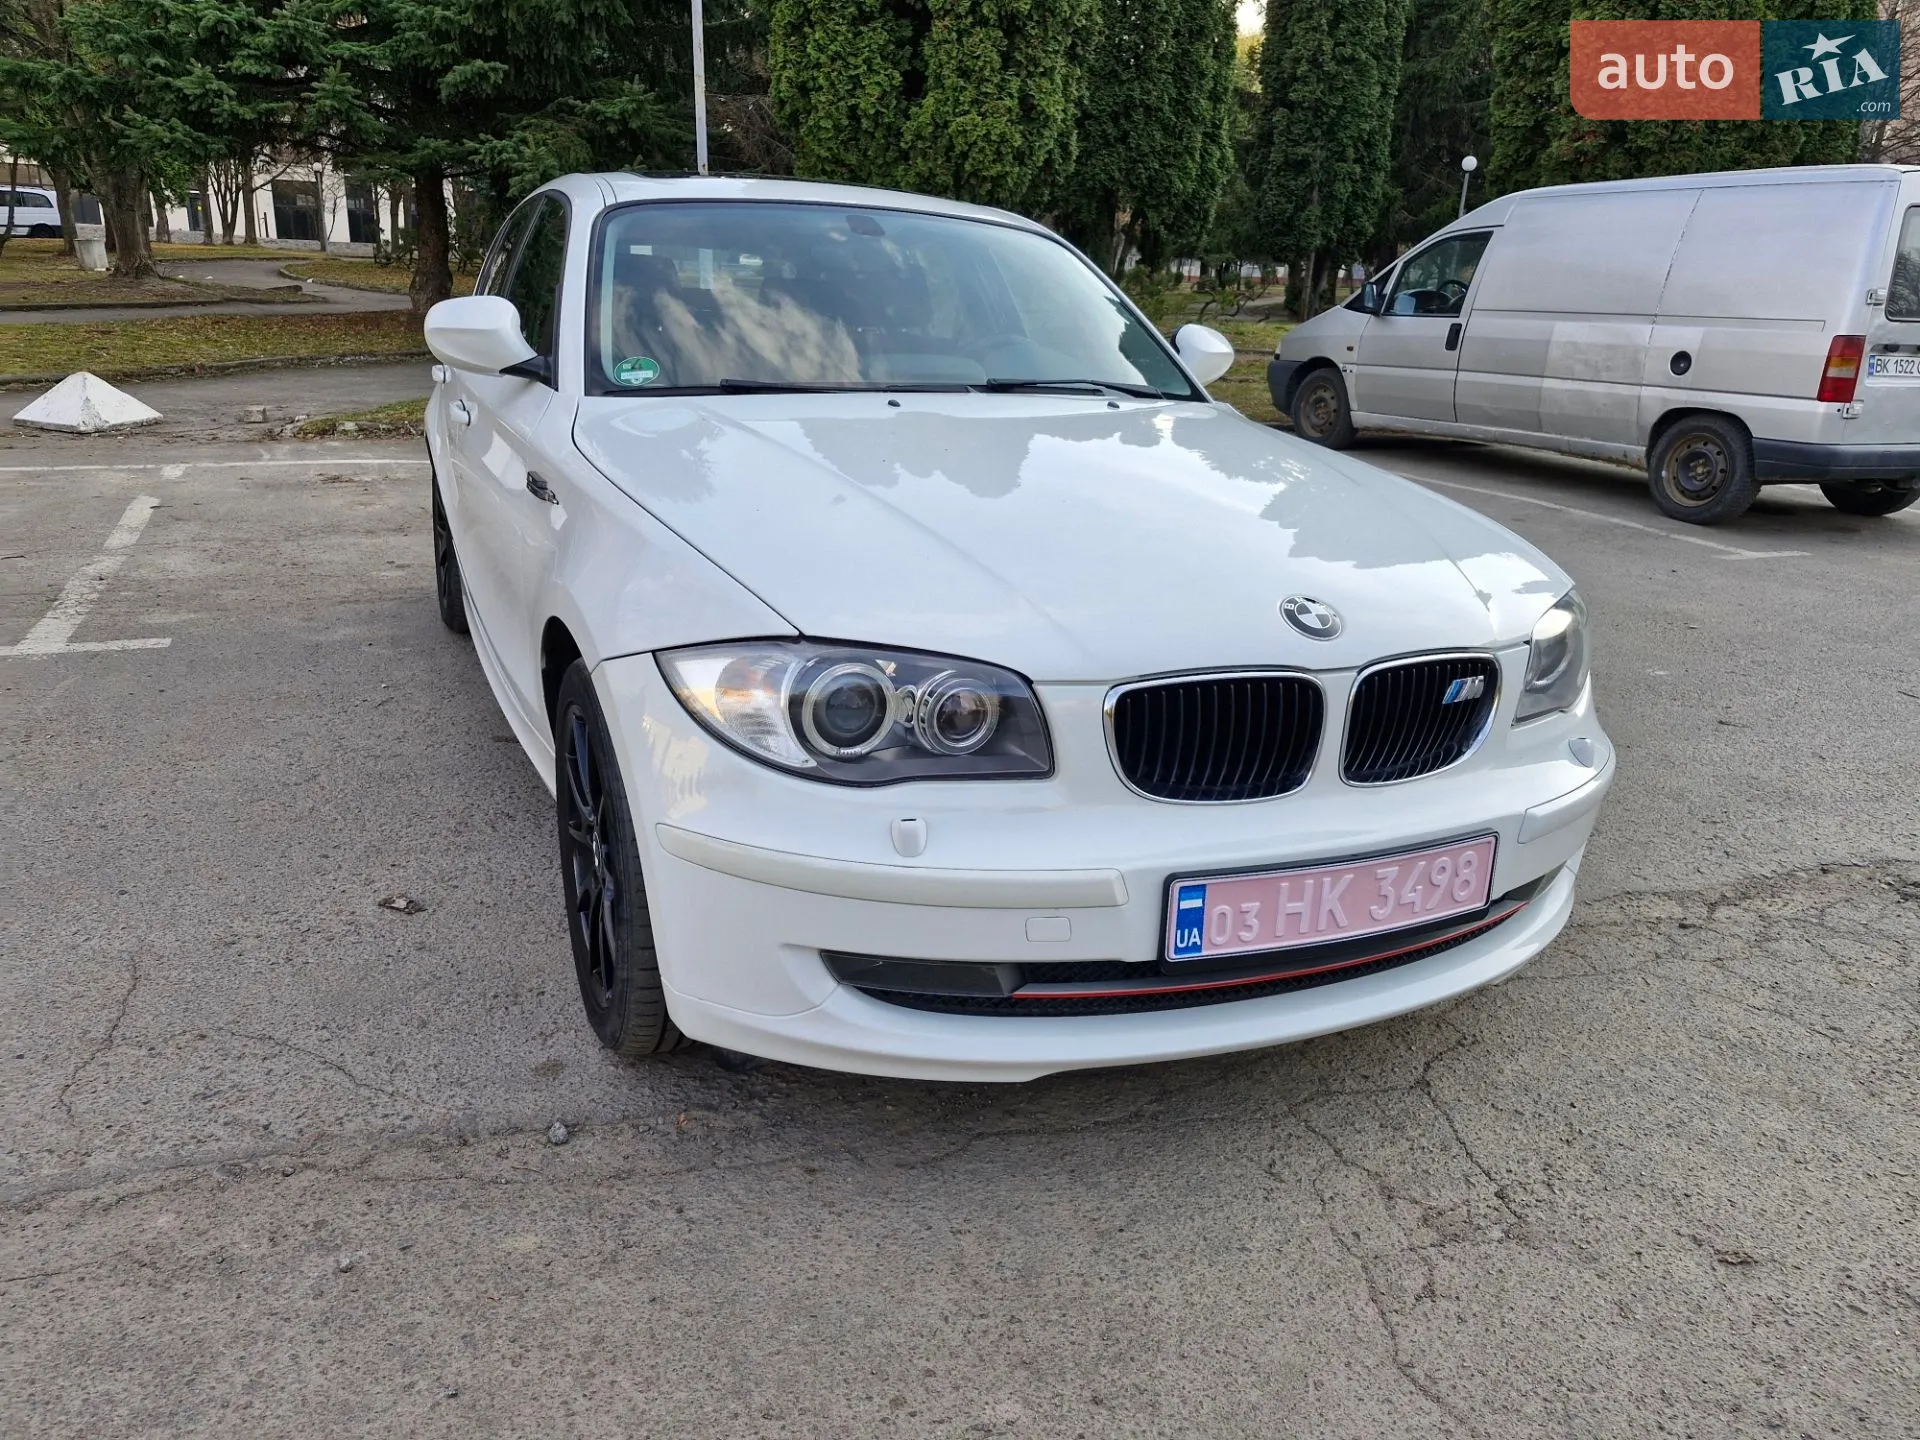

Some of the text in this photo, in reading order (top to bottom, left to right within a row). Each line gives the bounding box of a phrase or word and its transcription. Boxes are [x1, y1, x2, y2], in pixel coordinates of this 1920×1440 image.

[1875, 358, 1891, 374] BK
[1894, 359, 1916, 375] 1522
[1209, 850, 1480, 946] 03 HK 3498
[1176, 927, 1201, 948] UA
